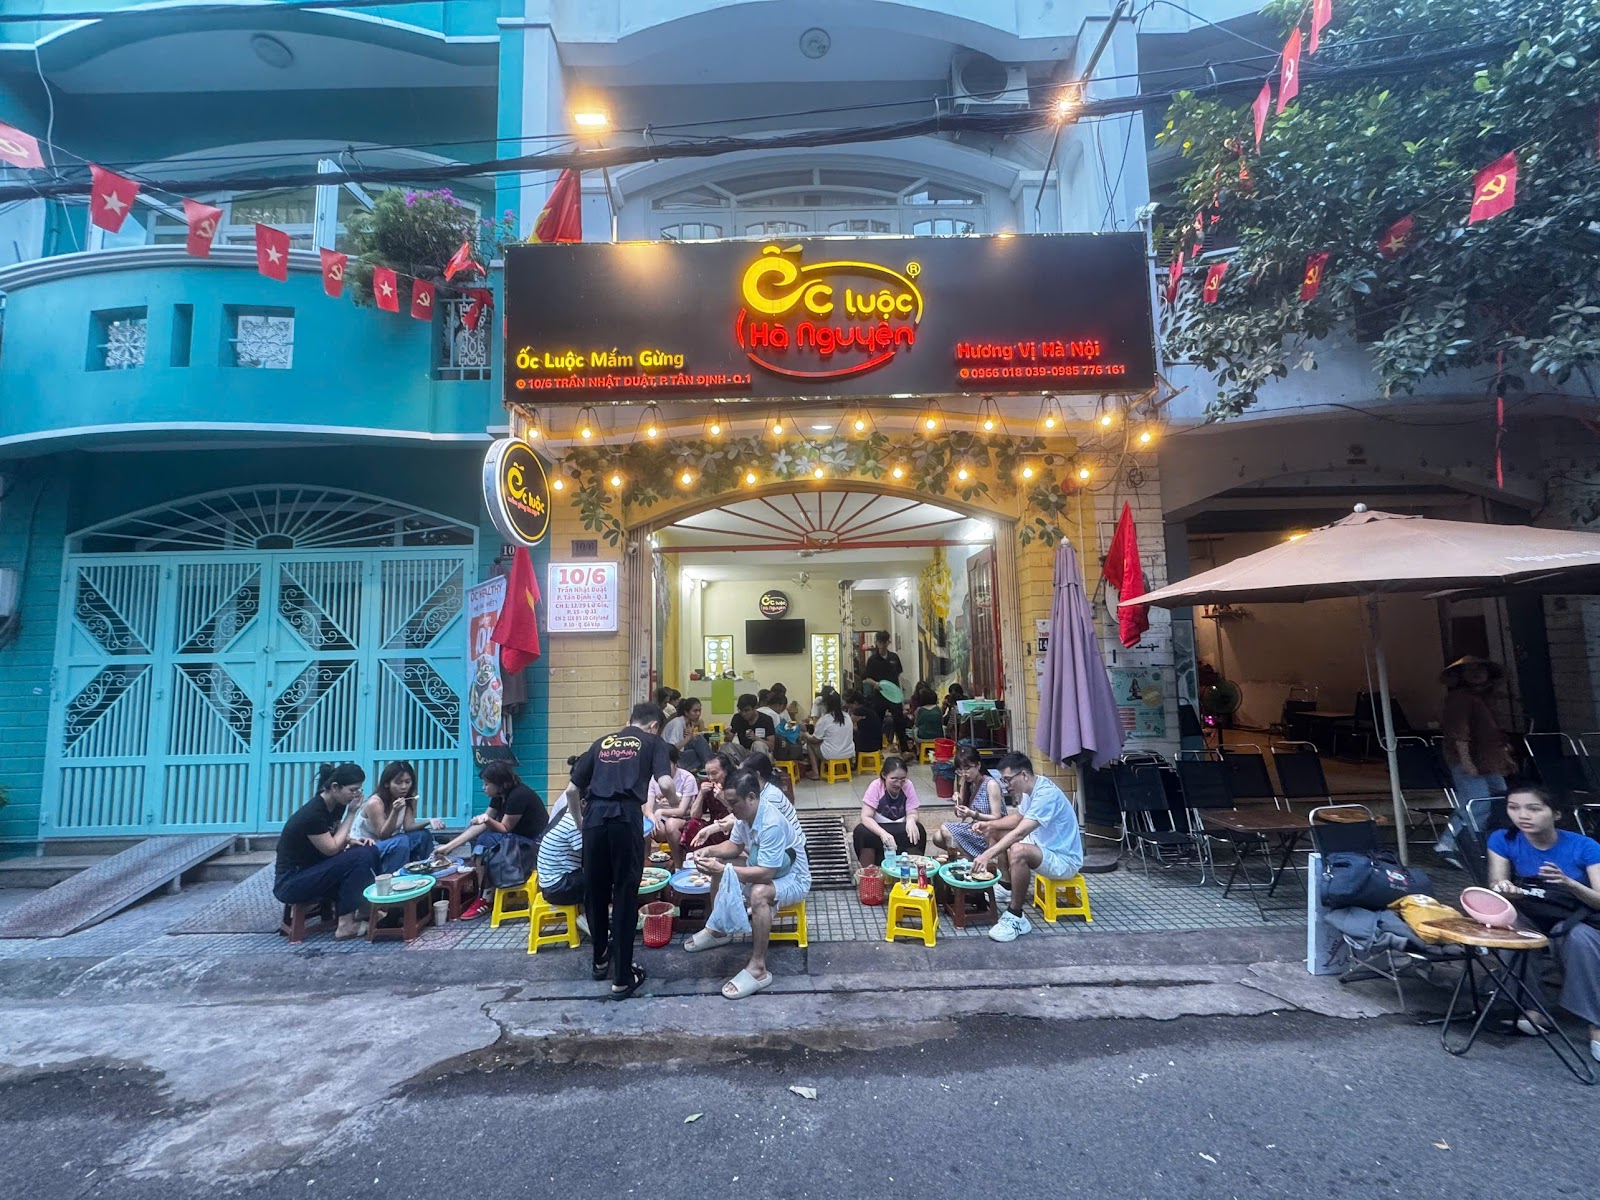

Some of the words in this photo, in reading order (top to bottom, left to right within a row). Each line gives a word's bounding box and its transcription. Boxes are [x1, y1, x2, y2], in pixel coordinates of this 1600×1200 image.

[743, 244, 834, 314] Ốc
[845, 289, 913, 319] luộc
[751, 322, 789, 347] Hà
[516, 346, 539, 369] Ốc
[544, 351, 584, 371] Luộc
[591, 347, 633, 368] Mắm
[639, 350, 684, 369] Gừng
[957, 342, 1013, 360] Hương
[1017, 341, 1036, 361] Vị
[1042, 340, 1065, 358] Hà
[1071, 339, 1101, 360] Nội
[528, 378, 552, 390] 10/6
[554, 374, 586, 388] TRẦN
[588, 374, 620, 389] NHẬT
[623, 373, 657, 389] DUẬT,
[670, 372, 694, 386] TÂN
[971, 368, 999, 378] 0966
[1002, 367, 1022, 377] 018
[1082, 365, 1102, 375] 776
[1105, 364, 1125, 375] 161
[559, 567, 606, 586] 10/6
